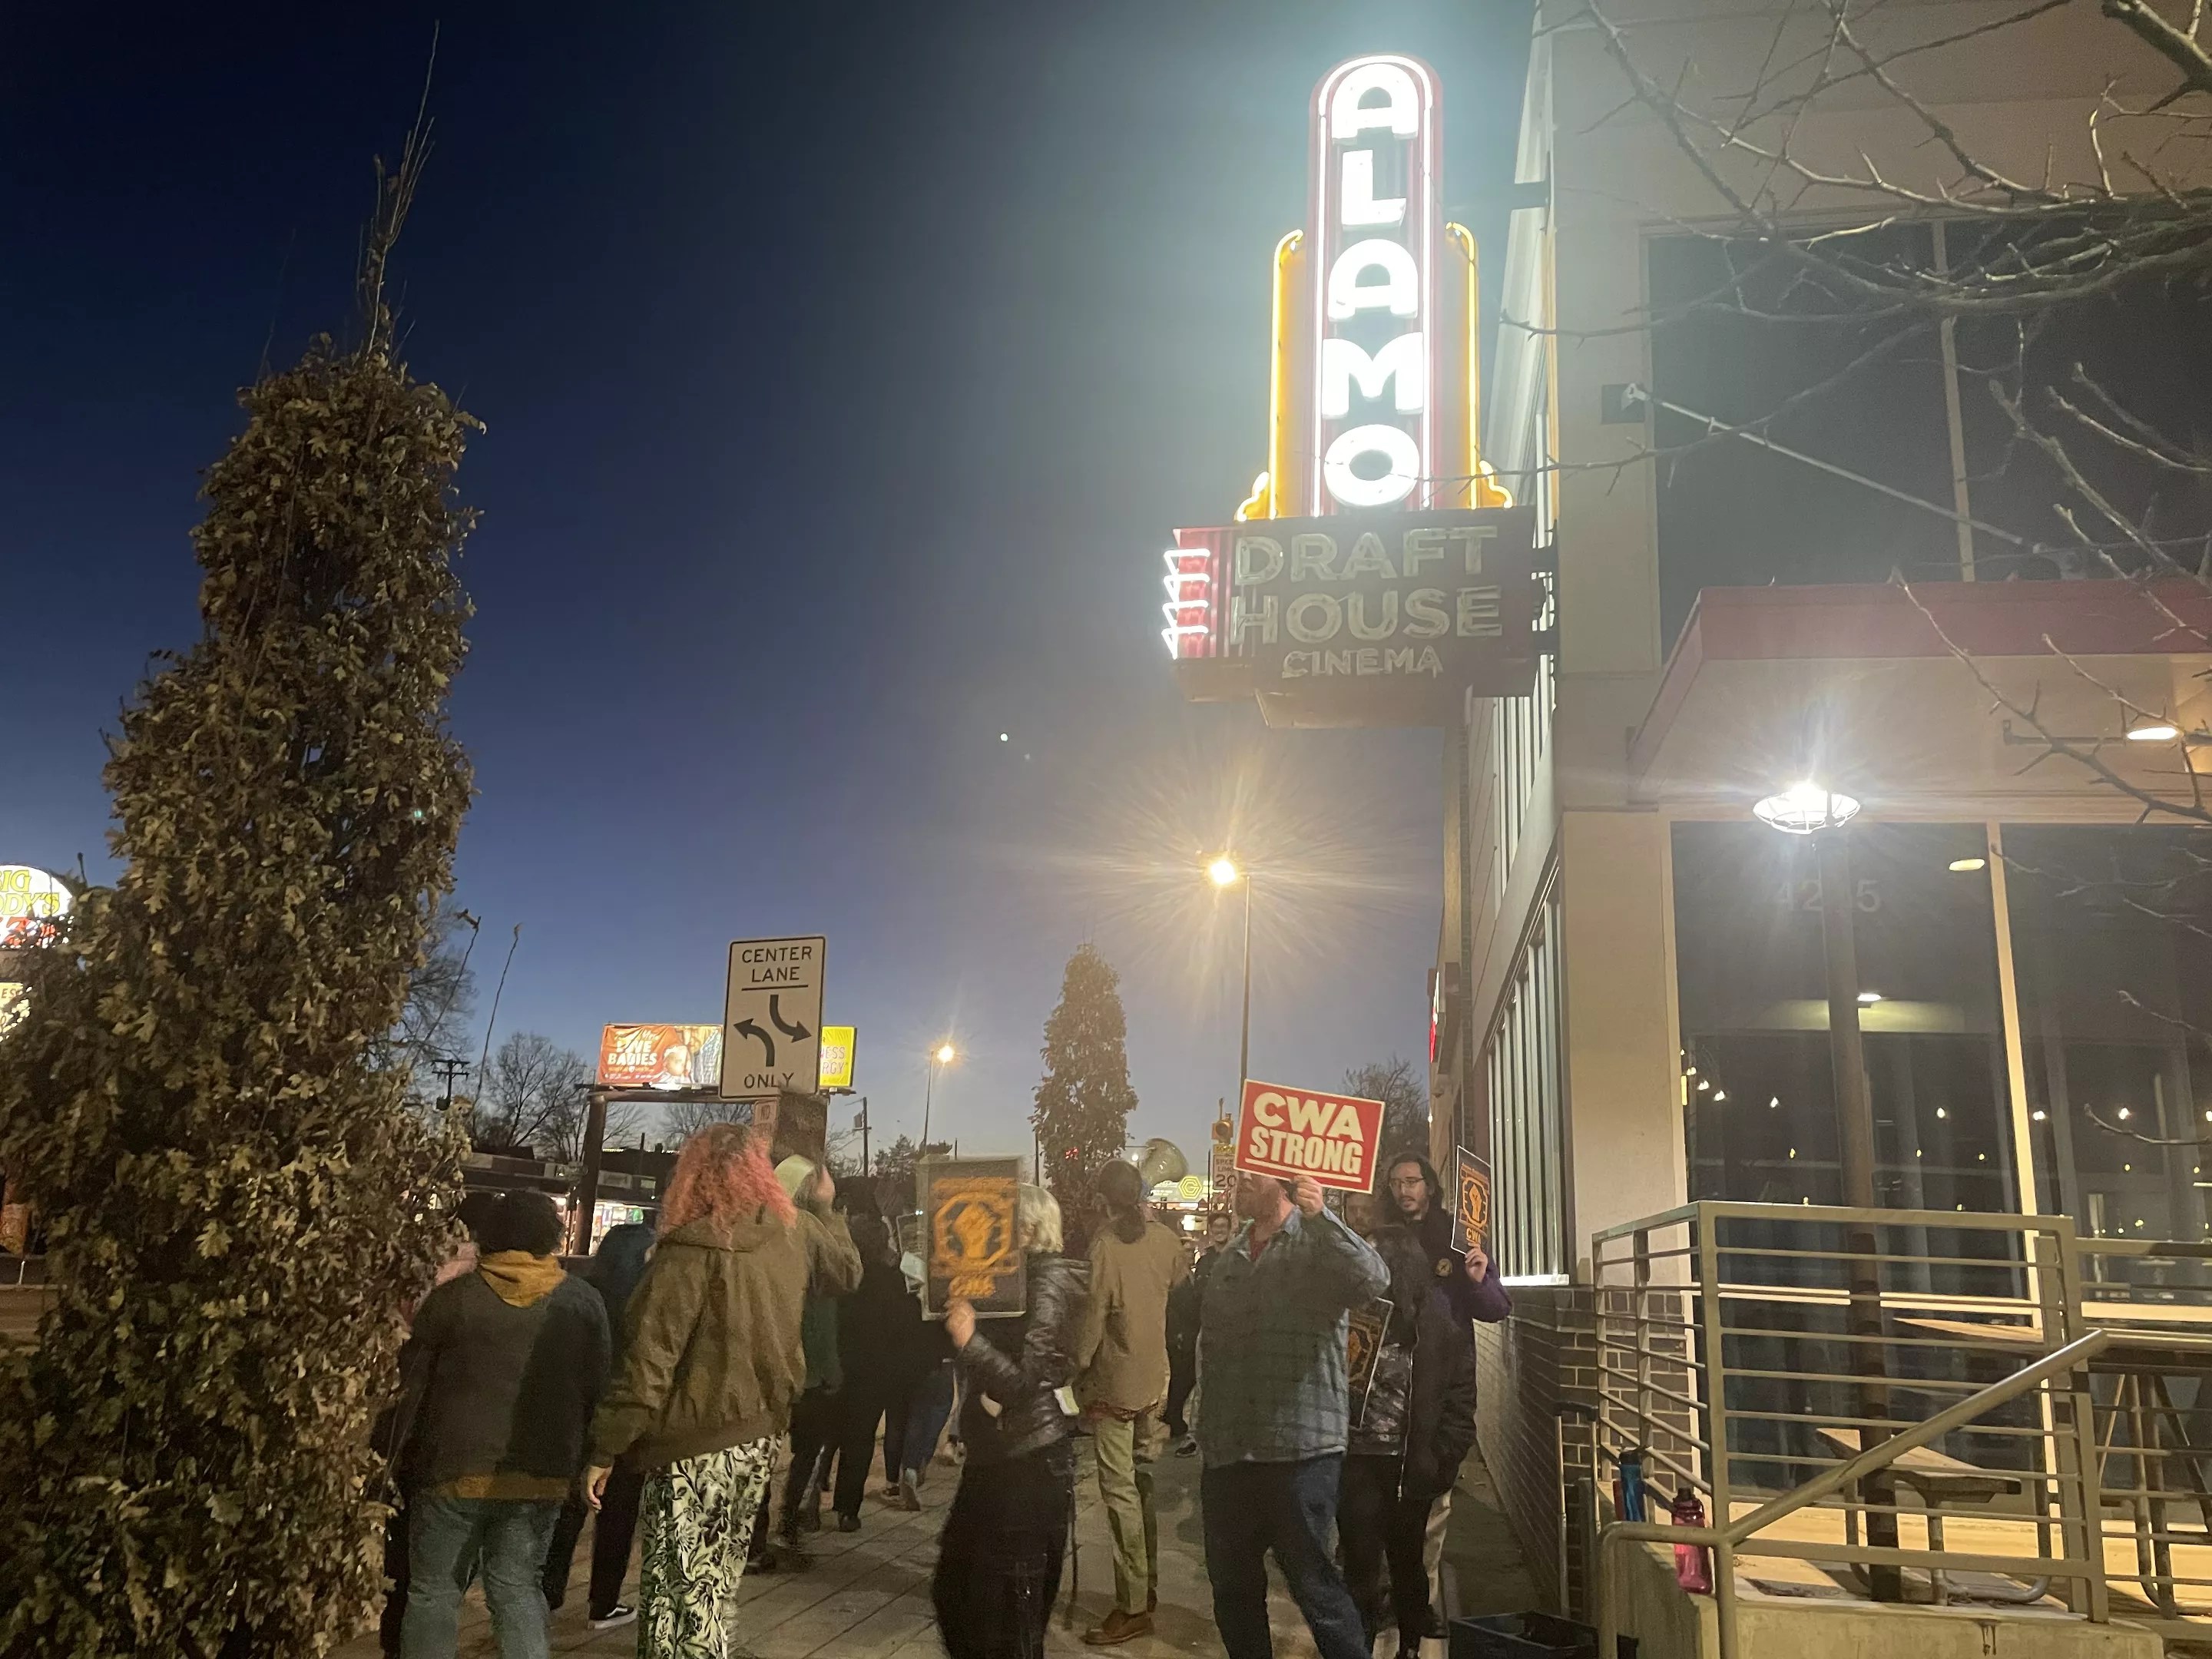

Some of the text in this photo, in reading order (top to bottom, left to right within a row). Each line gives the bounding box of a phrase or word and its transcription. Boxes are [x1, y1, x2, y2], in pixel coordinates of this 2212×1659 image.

[1322, 62, 1424, 508] ALAMO
[1233, 525, 1498, 586] DRAFT
[1230, 585, 1502, 645] HOUSE
[1281, 645, 1445, 679] CINEMA
[0, 869, 31, 892] IG
[1773, 879, 1881, 913] 425
[0, 892, 60, 916] DY'S
[742, 945, 813, 963] CENTER
[752, 966, 801, 982] LANE
[744, 1072, 794, 1089] ONLY
[1253, 1092, 1364, 1142] CWA
[1250, 1126, 1363, 1174] STRONG
[1216, 1174, 1237, 1187] 20
